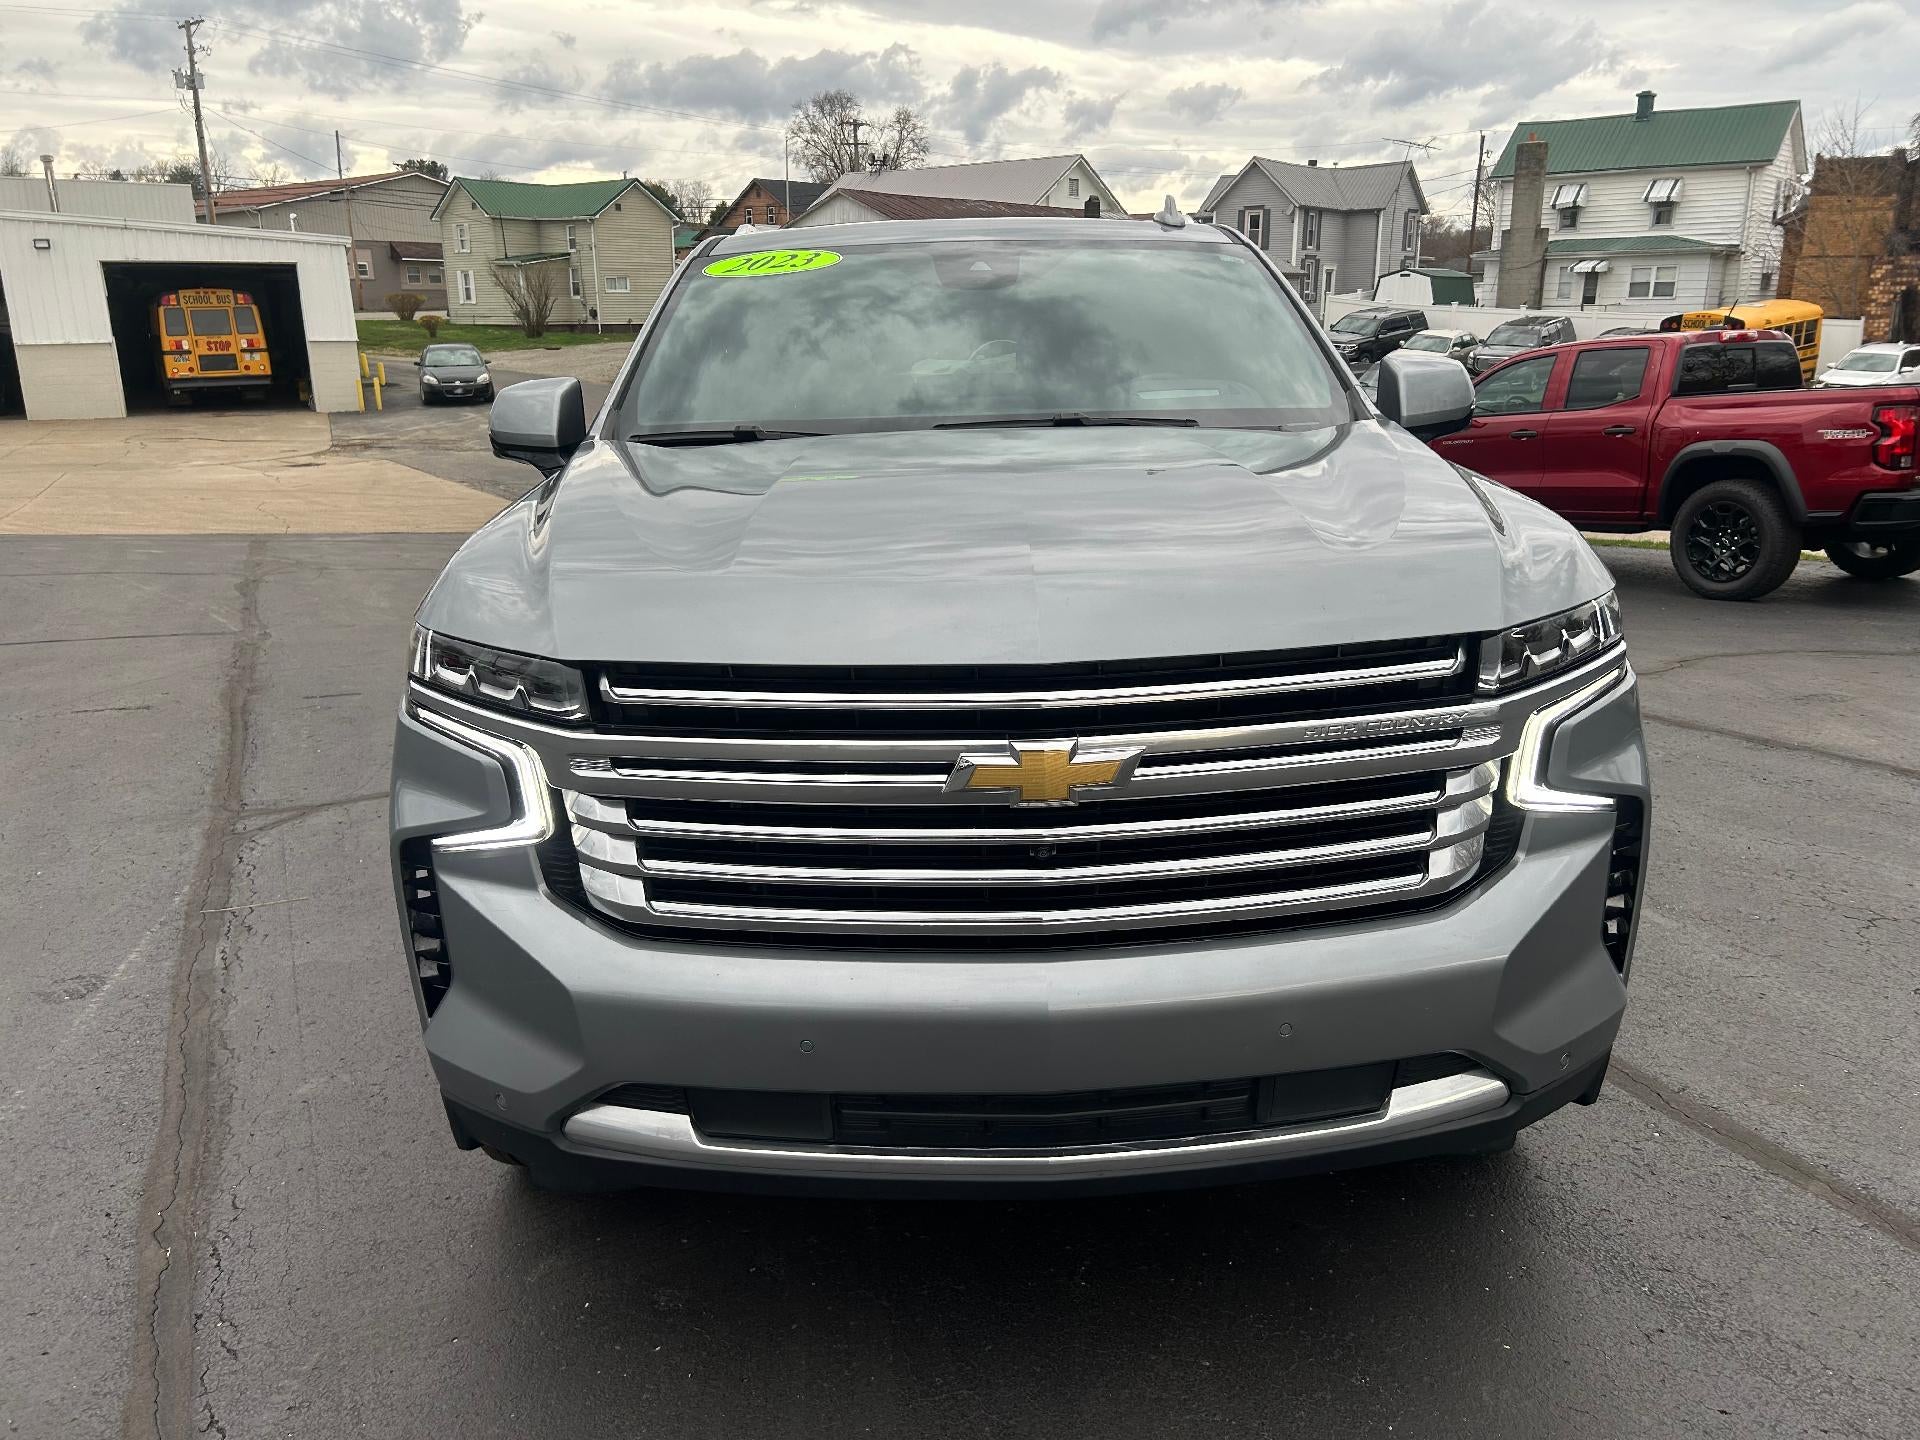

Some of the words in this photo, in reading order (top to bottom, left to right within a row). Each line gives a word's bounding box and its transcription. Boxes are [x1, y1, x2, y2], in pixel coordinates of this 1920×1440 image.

[721, 252, 822, 274] 2023
[183, 295, 213, 305] SCHOOL
[216, 294, 231, 304] BUS
[1682, 319, 1706, 328] SCHOOL
[206, 340, 231, 352] STOP
[1304, 723, 1358, 738] HIGH
[1366, 712, 1469, 732] COUNTRY
